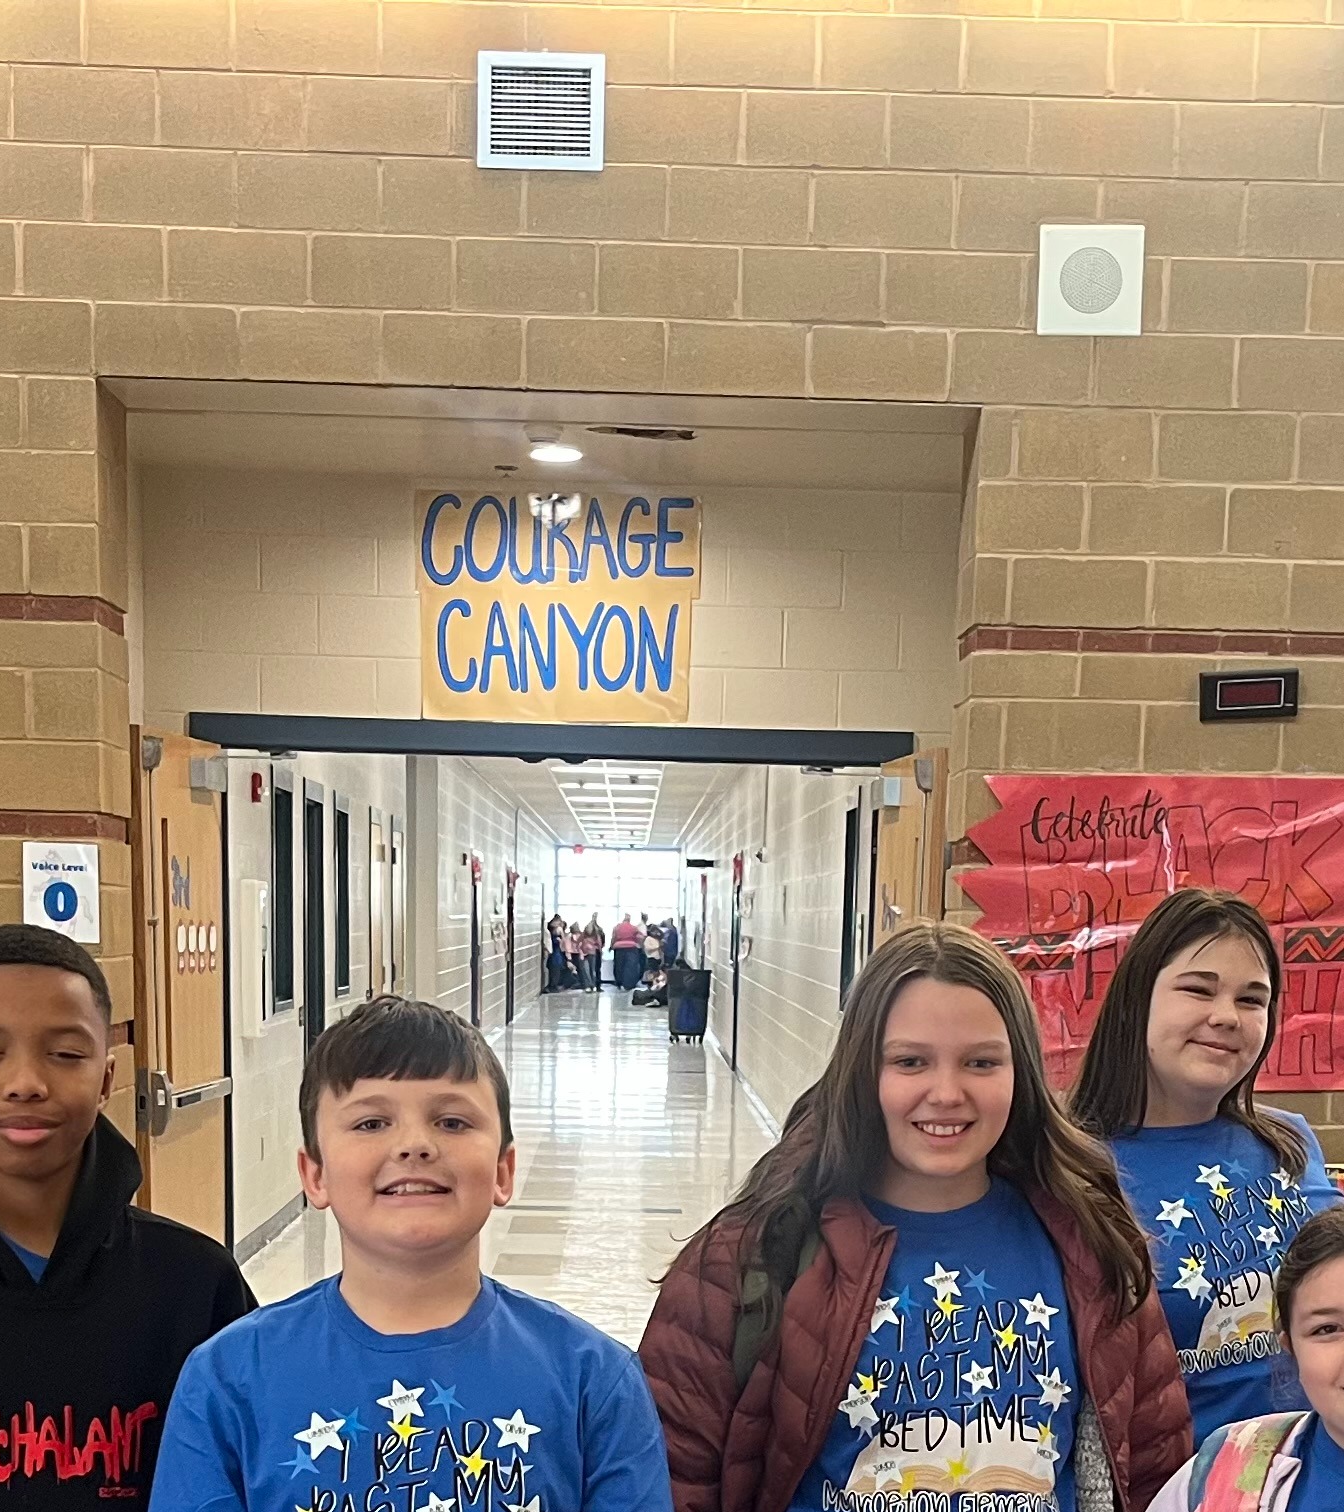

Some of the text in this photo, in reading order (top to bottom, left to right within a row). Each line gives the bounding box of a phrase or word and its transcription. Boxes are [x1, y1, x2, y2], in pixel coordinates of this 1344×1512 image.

[421, 494, 695, 586] COURAGE
[437, 599, 679, 693] CANYON
[1031, 788, 1167, 844] Celebrate
[31, 862, 59, 871] Voice
[1020, 800, 1343, 936] BLACK
[44, 882, 78, 921] 0
[1209, 1176, 1276, 1230] READ
[1186, 1219, 1260, 1273] PAST
[925, 1300, 1018, 1353] READ
[1176, 1329, 1281, 1374] onroeton
[871, 1326, 1050, 1405] PAST MY
[374, 1419, 490, 1483] READ
[879, 1393, 1041, 1453] BEDTIME
